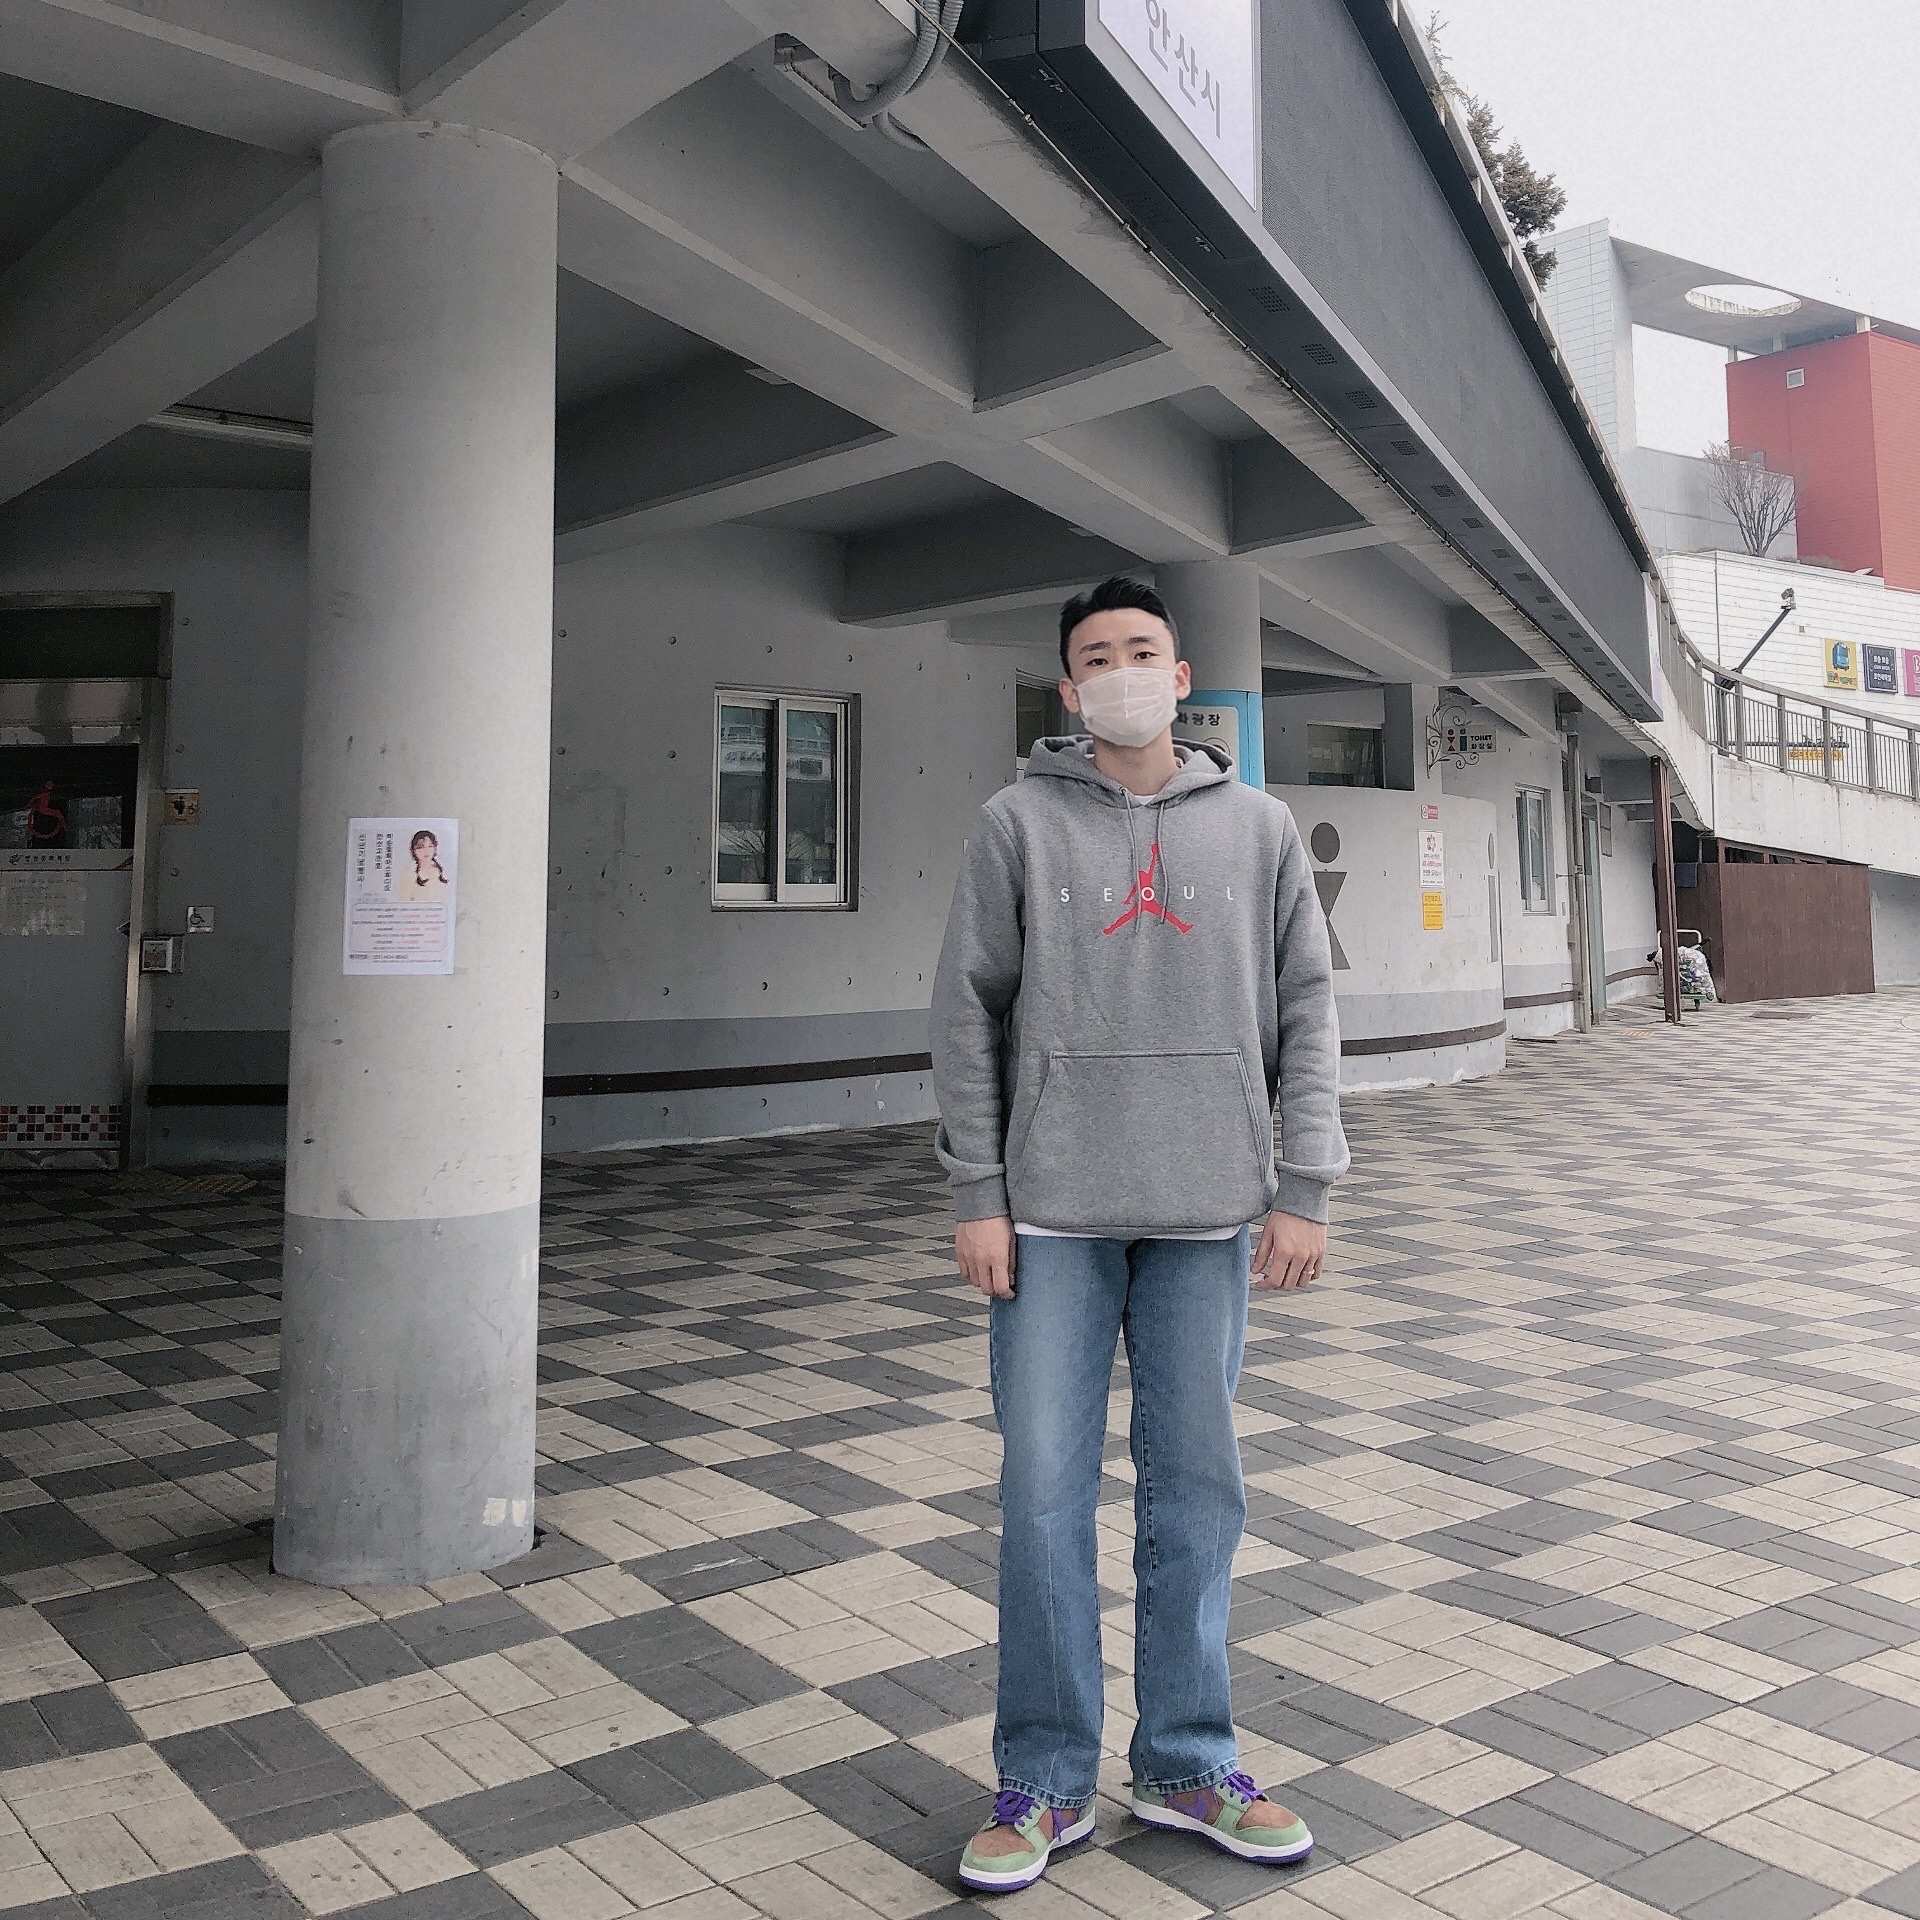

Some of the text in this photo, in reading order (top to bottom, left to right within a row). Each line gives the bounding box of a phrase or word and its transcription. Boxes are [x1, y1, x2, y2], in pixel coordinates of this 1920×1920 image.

[1145, 0, 1221, 139] 안산시
[1470, 742, 1493, 750] 화장실
[1060, 885, 1234, 903] SEOUL
